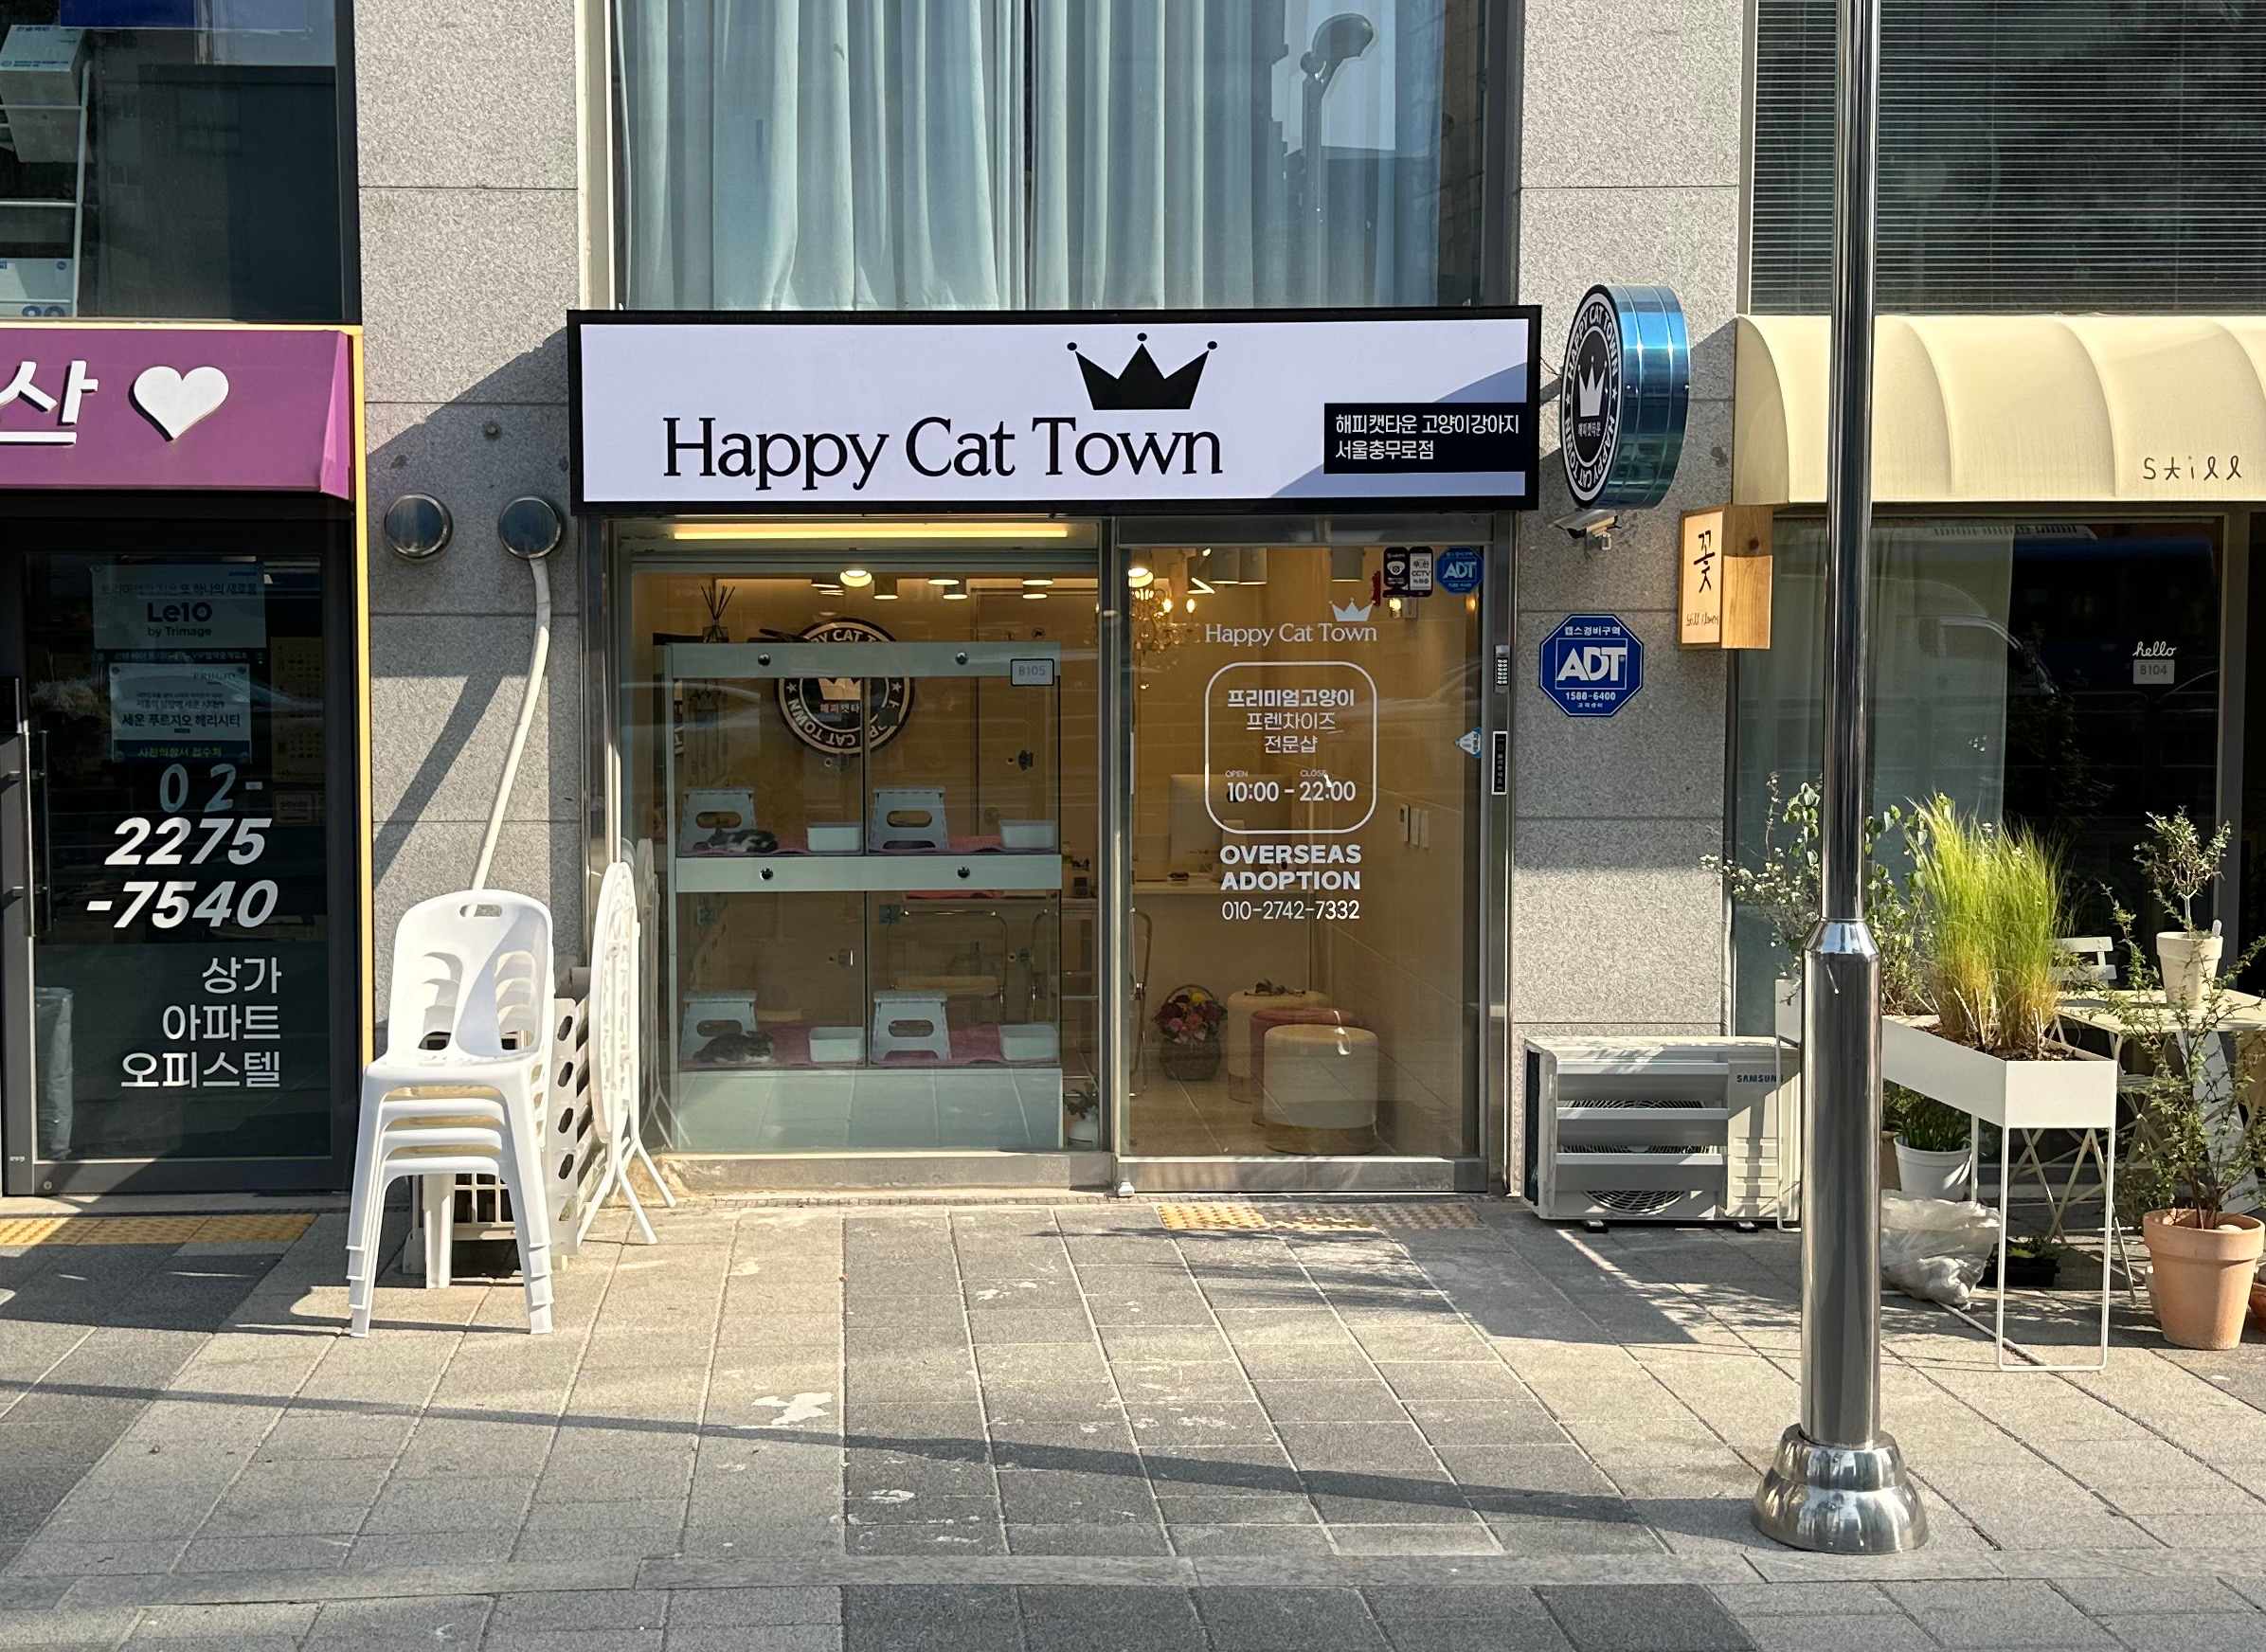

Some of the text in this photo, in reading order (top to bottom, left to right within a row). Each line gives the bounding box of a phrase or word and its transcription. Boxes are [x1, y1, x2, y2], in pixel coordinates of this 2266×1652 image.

[1568, 306, 1618, 381] HAPPY CAT TOWN
[1335, 414, 1520, 434] 해피캣타운 고양이강아지
[663, 417, 1223, 491] Happy Cat Town
[1335, 440, 1434, 460] 서울충무로점
[1565, 415, 1615, 489] HAPPY CAT TOWN
[1443, 561, 1477, 579] ADT
[148, 626, 212, 637] by Trimage
[1205, 622, 1377, 647] Happy Cat Town
[2132, 640, 2177, 657] hello
[1017, 665, 1047, 676] B105
[1556, 646, 1628, 681] ADT
[2139, 665, 2167, 675] B104
[1228, 689, 1355, 708] 프리미엄고양이
[788, 698, 856, 746] CAT TOWN
[1246, 711, 1337, 730] 프렌차이즈
[1264, 734, 1318, 754] 전문샵
[1227, 781, 1279, 802] 10:00
[1300, 781, 1357, 802] 22:00
[104, 817, 273, 866] 2275
[1219, 844, 1361, 865] OVERSEAS
[1220, 871, 1360, 891] ADOPTION
[1221, 900, 1360, 921] 010-2742-7332
[202, 957, 282, 995] 상가
[162, 1004, 281, 1042] 아파트
[120, 1051, 281, 1089] 오피스텔
